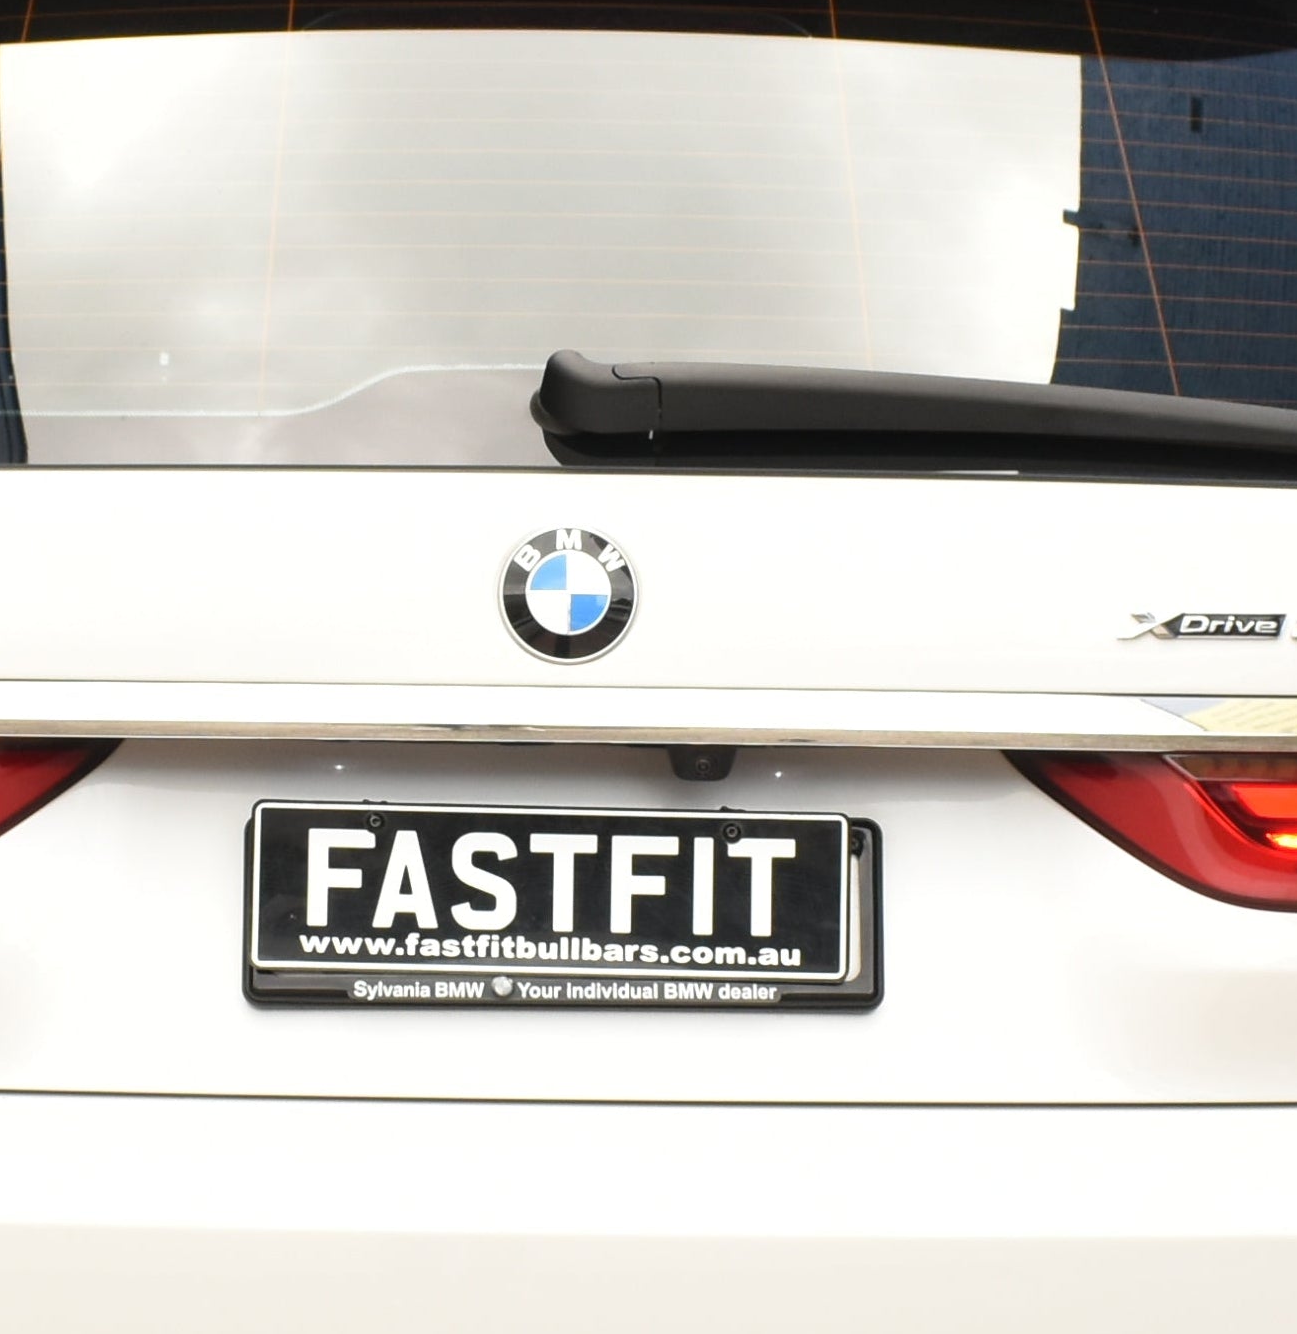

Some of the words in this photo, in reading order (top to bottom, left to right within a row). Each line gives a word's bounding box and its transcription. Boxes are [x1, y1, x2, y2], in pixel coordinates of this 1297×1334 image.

[513, 528, 626, 572] BMW
[306, 828, 796, 936] FASTFIT
[299, 933, 801, 966] www.fastfitbullbars.com.au
[353, 980, 431, 1001] Sylvania
[435, 981, 485, 998] BMW
[517, 982, 562, 999] Your
[664, 983, 713, 1000] BMW
[718, 983, 778, 1000] dealer
